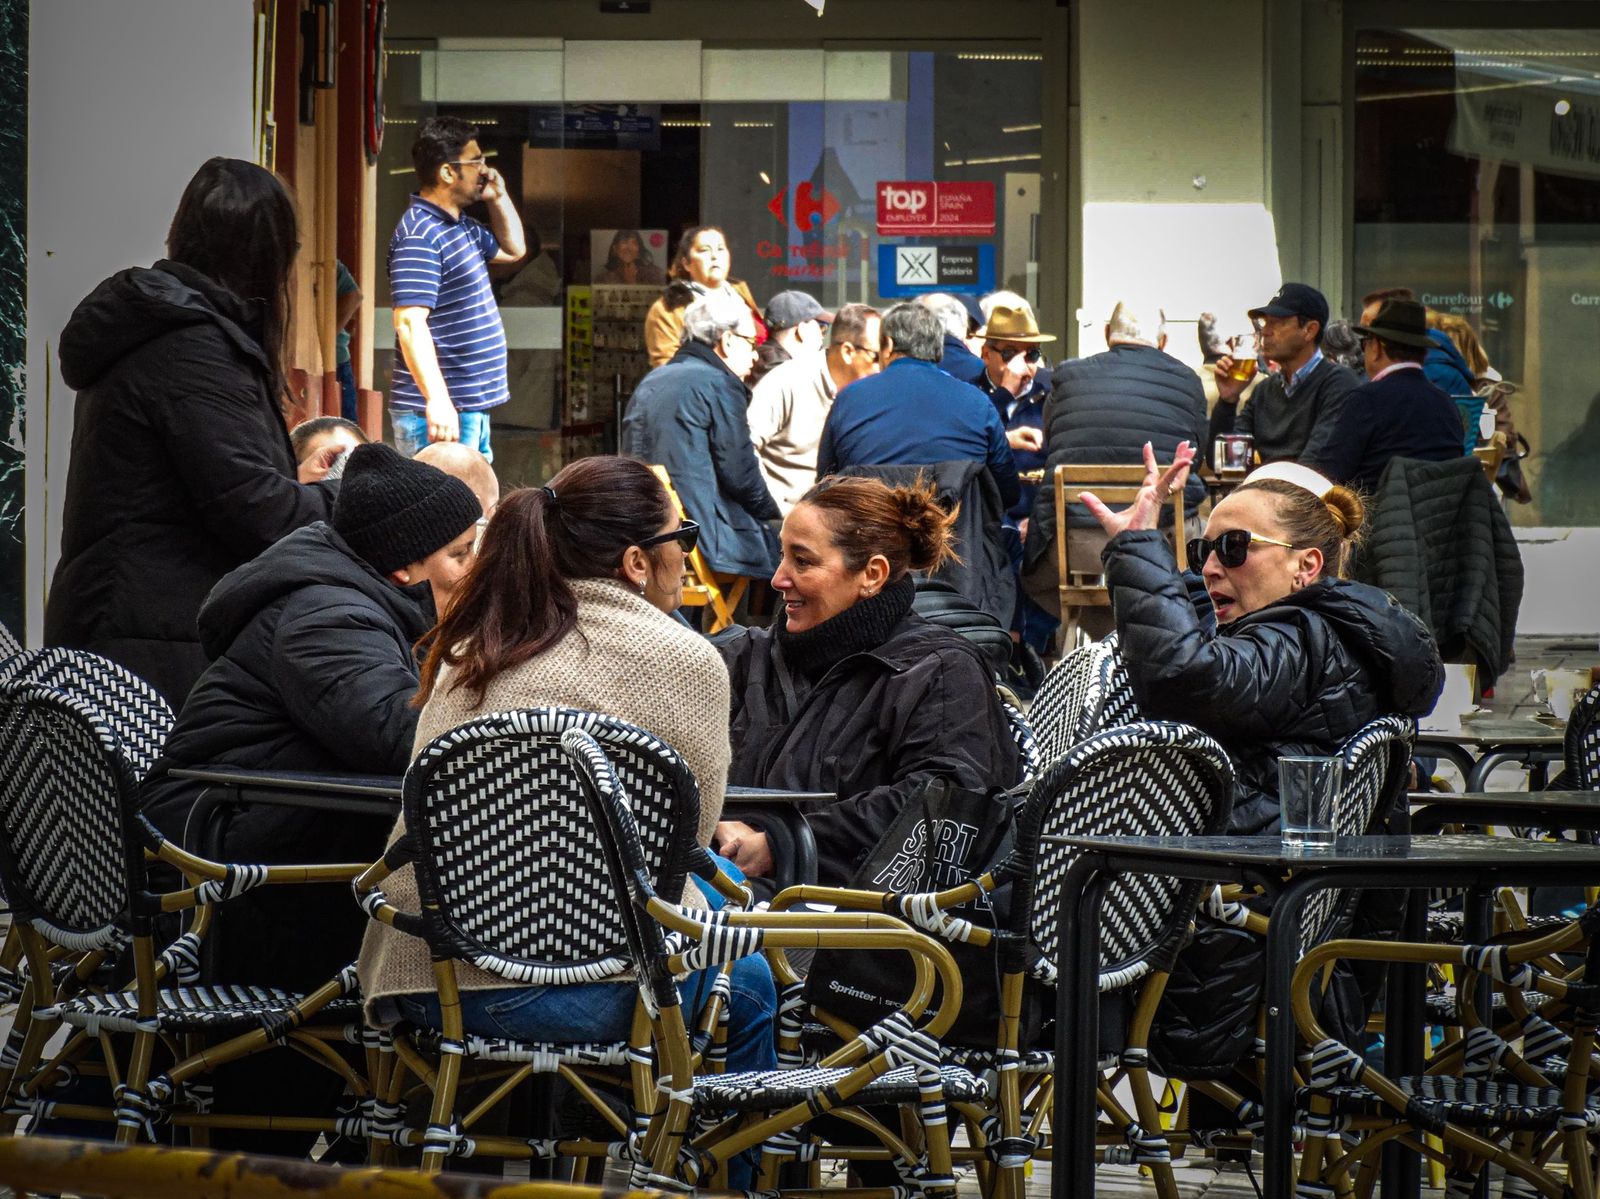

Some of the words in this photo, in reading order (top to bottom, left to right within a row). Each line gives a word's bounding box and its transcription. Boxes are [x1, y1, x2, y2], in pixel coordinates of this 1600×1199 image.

[881, 185, 927, 214] top
[939, 194, 972, 202] ESPAÑA
[939, 202, 964, 210] SPAIN
[886, 214, 927, 222] EMPLOYER
[940, 214, 959, 222] 2024
[941, 256, 973, 264] Empresa
[942, 268, 973, 276] Solidaria
[1421, 292, 1484, 305] Carrefour
[829, 980, 877, 1002] Sprinter
